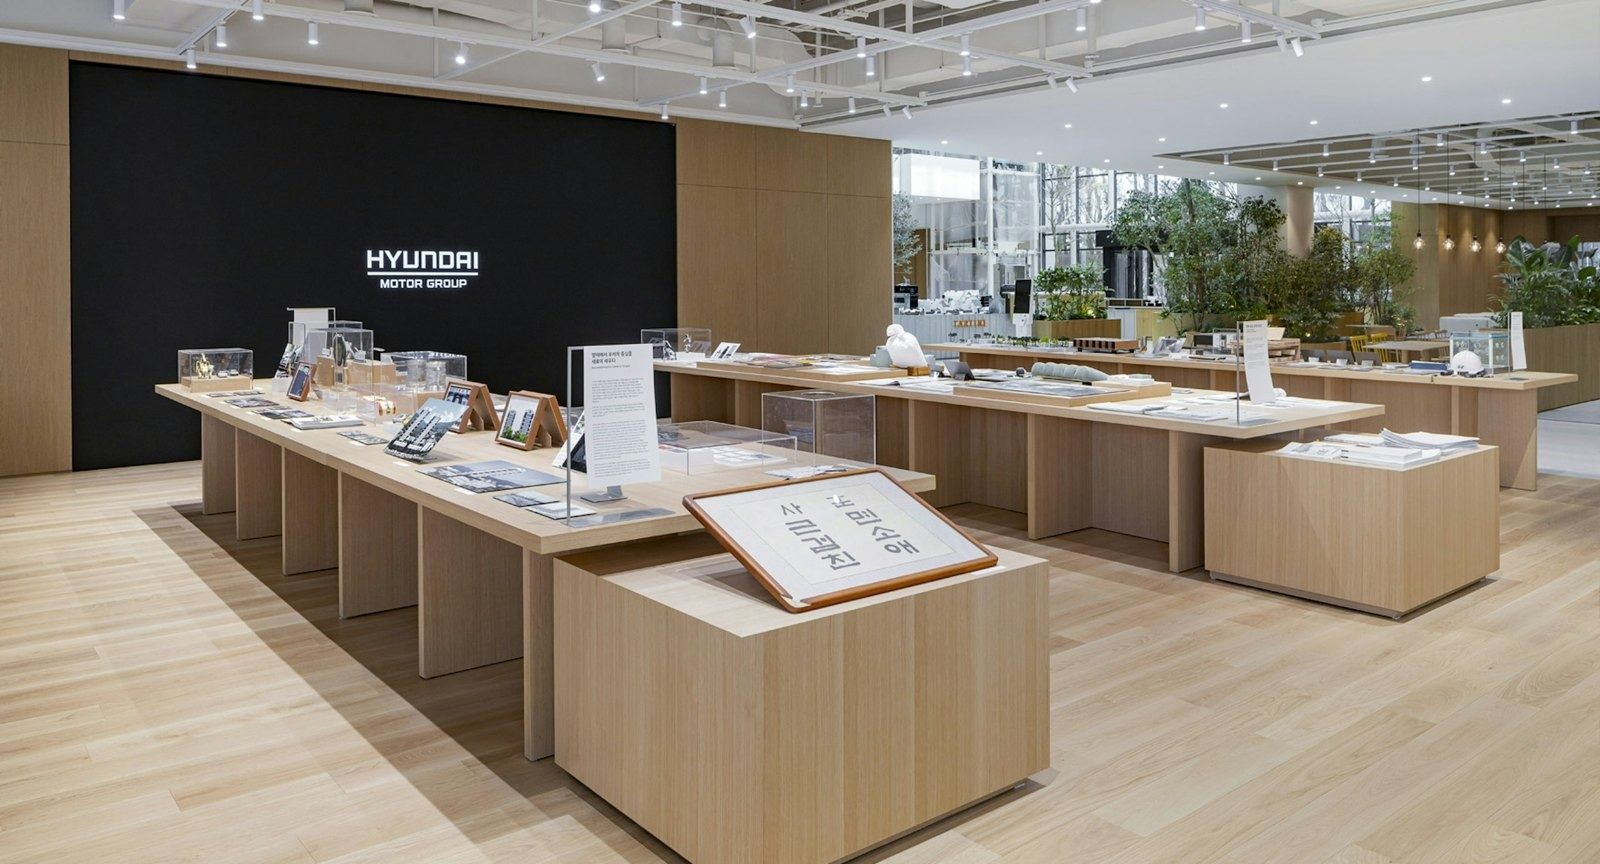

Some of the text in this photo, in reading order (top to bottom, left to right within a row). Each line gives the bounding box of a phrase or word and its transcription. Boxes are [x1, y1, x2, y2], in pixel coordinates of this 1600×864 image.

[367, 250, 479, 269] HYUNDAI
[380, 279, 467, 288] MOTOR GROUP
